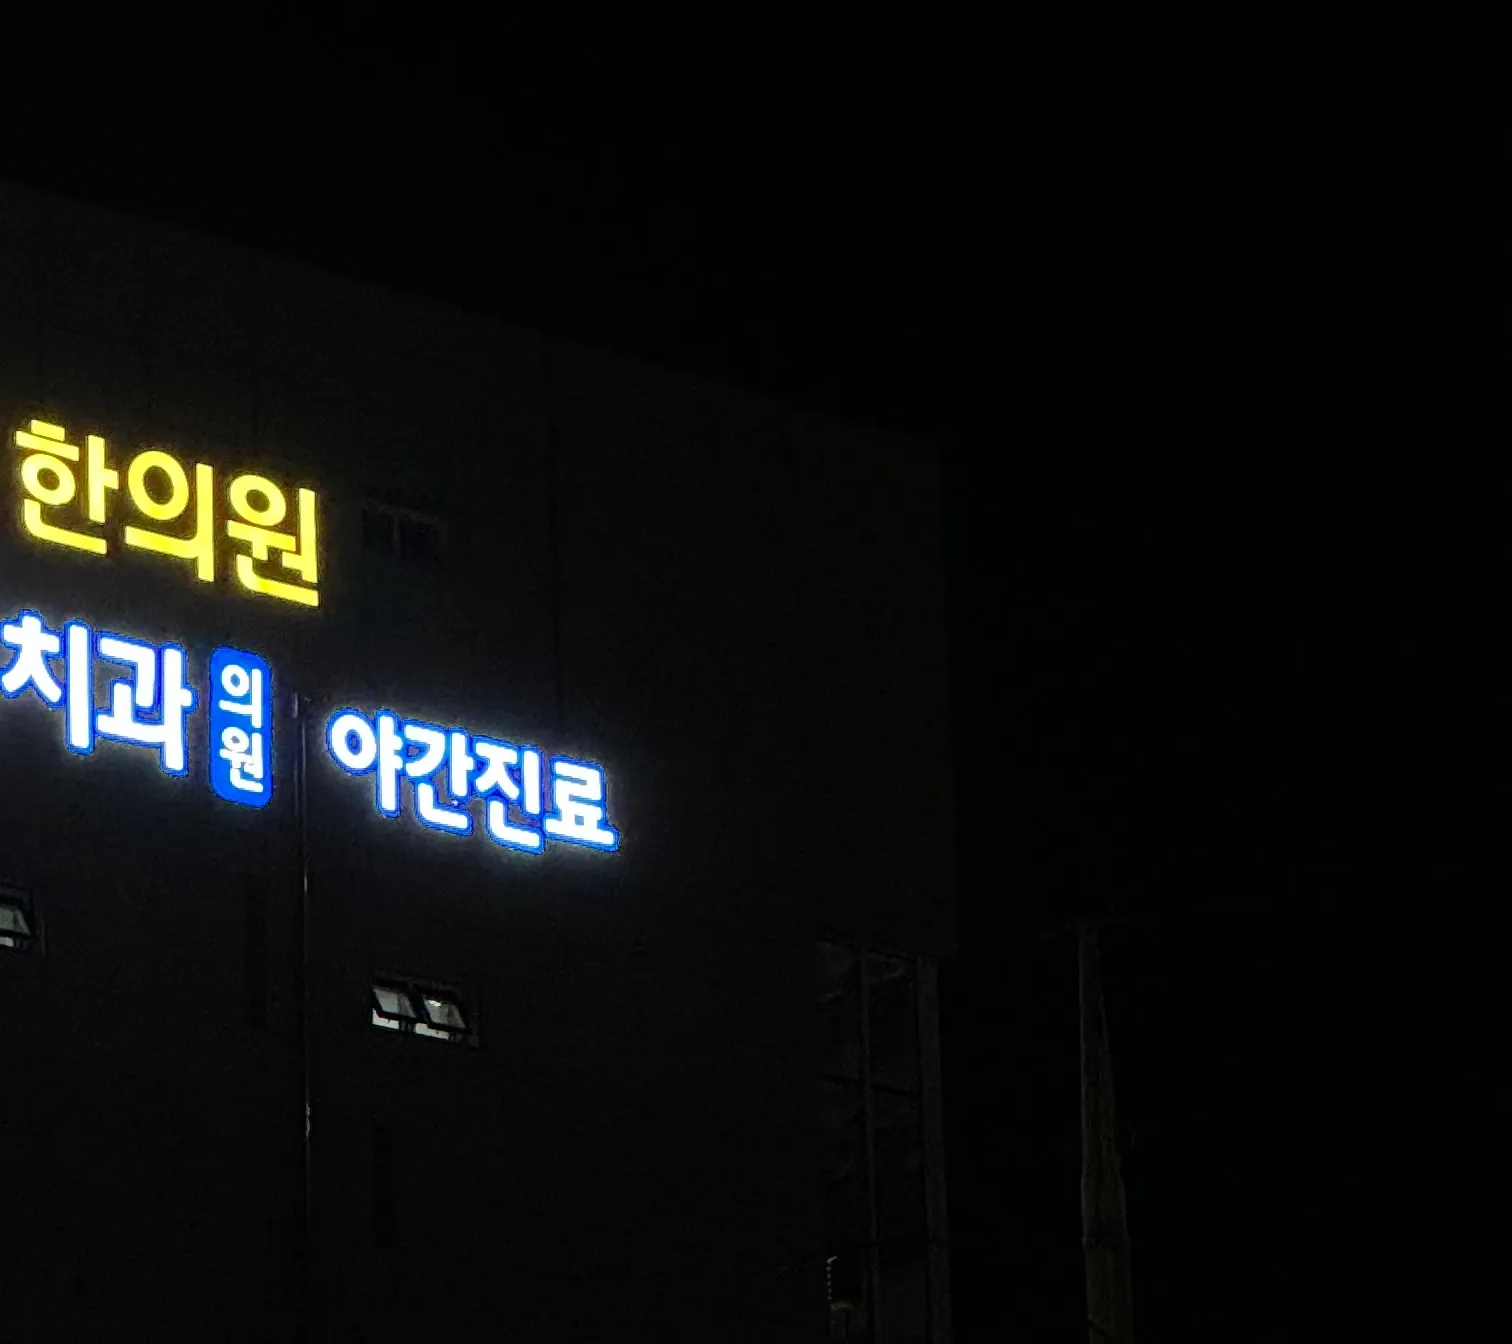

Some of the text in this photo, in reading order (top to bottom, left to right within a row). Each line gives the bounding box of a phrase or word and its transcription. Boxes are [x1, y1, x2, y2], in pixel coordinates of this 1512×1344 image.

[14, 420, 320, 607] 한의원
[219, 664, 264, 793] 의원
[329, 712, 616, 849] 야간진료
